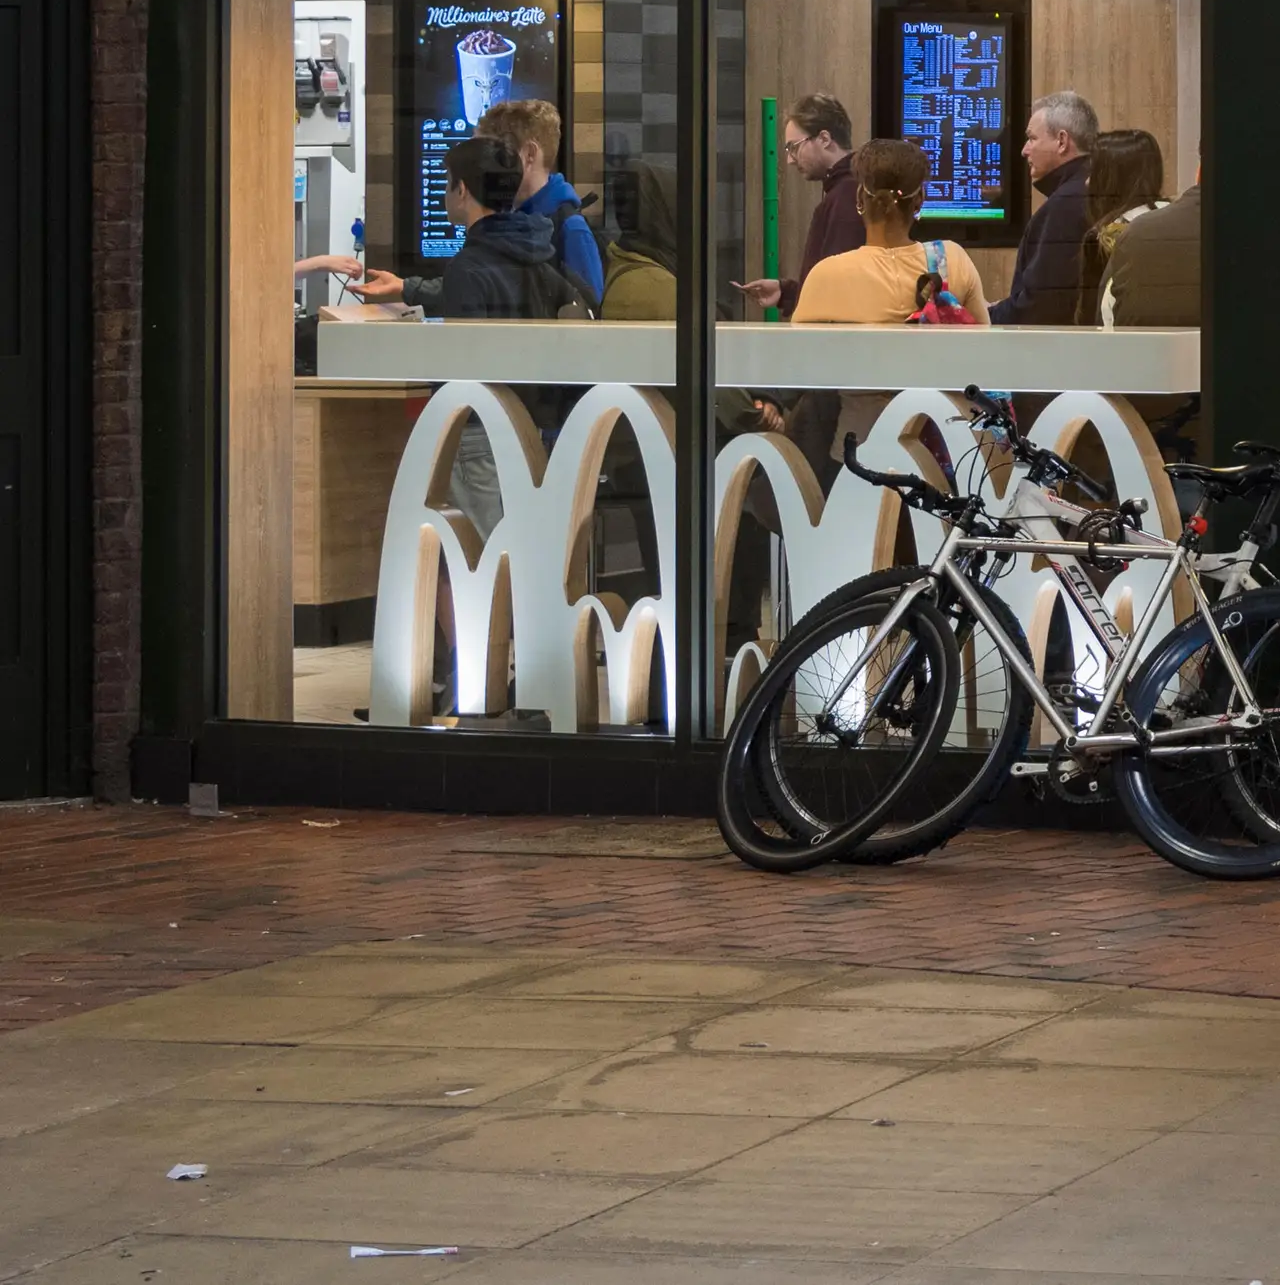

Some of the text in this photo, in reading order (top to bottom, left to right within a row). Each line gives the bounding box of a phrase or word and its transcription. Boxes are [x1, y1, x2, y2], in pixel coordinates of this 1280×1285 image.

[426, 5, 546, 28] Millionaire's Latte
[904, 23, 943, 34] Our Menu
